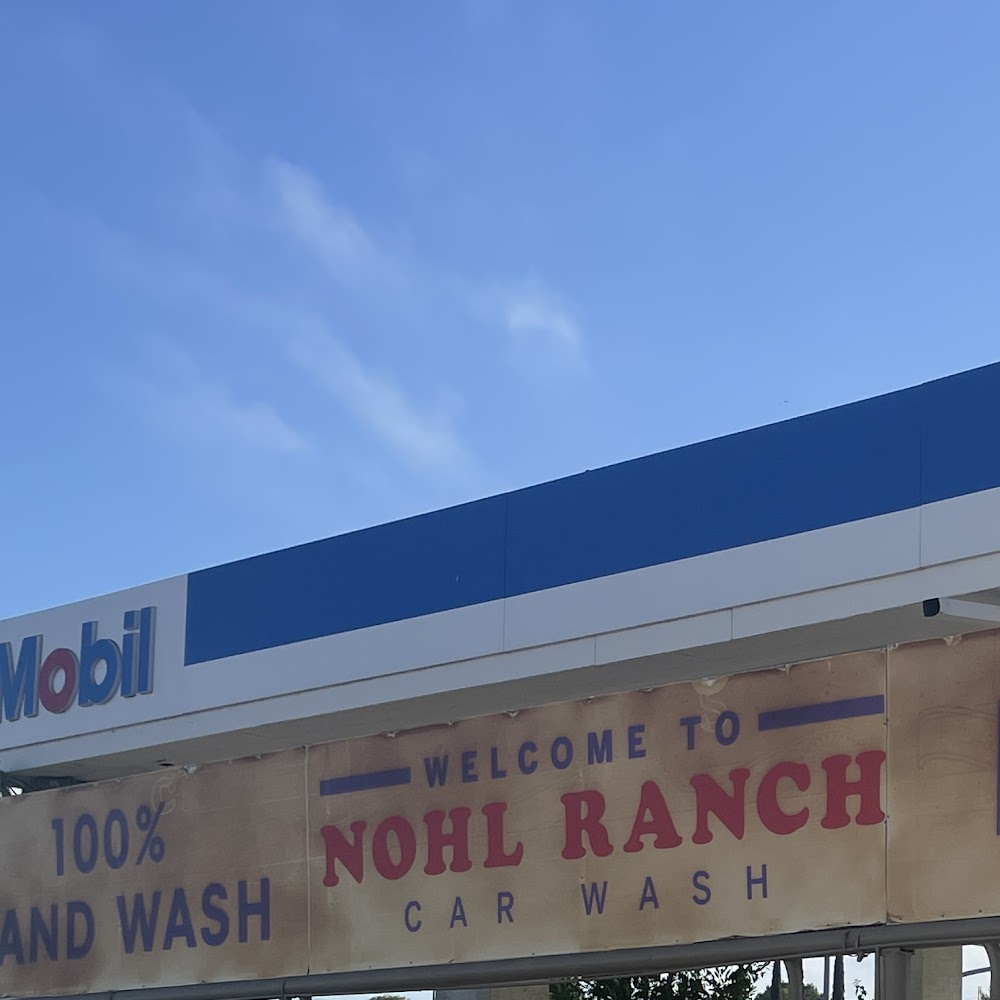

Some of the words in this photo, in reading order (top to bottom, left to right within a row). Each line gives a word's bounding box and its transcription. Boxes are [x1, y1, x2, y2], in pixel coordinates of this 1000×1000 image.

[0, 605, 156, 723] Mobil
[424, 723, 647, 788] WELCOME
[680, 711, 741, 750] TO
[51, 802, 165, 876] 100%
[320, 802, 523, 887] NOHL
[560, 750, 886, 860] RANCH
[117, 877, 270, 954] WASH
[404, 892, 515, 932] CAR
[581, 864, 768, 916] WASH
